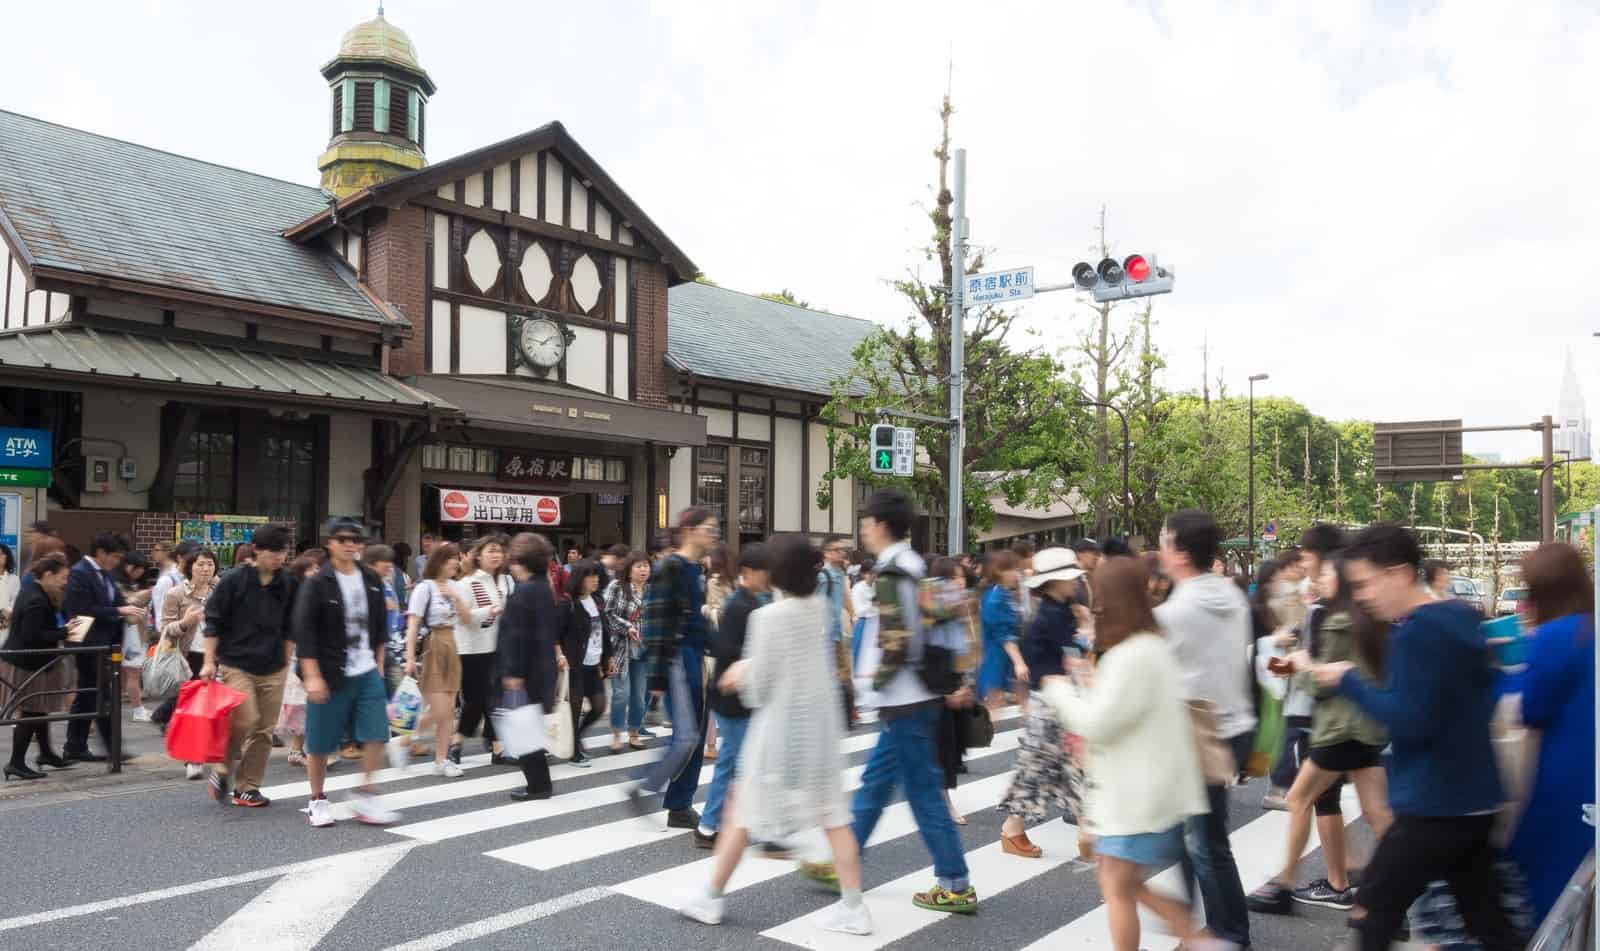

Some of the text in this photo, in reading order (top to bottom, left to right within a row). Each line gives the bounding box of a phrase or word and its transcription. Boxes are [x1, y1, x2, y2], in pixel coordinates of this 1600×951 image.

[970, 272, 1028, 292] 原宿駅前
[6, 437, 37, 449] ATM
[6, 448, 40, 458] コーナー
[479, 493, 528, 505] EXIT ONLY
[473, 505, 533, 523] 出口専用
